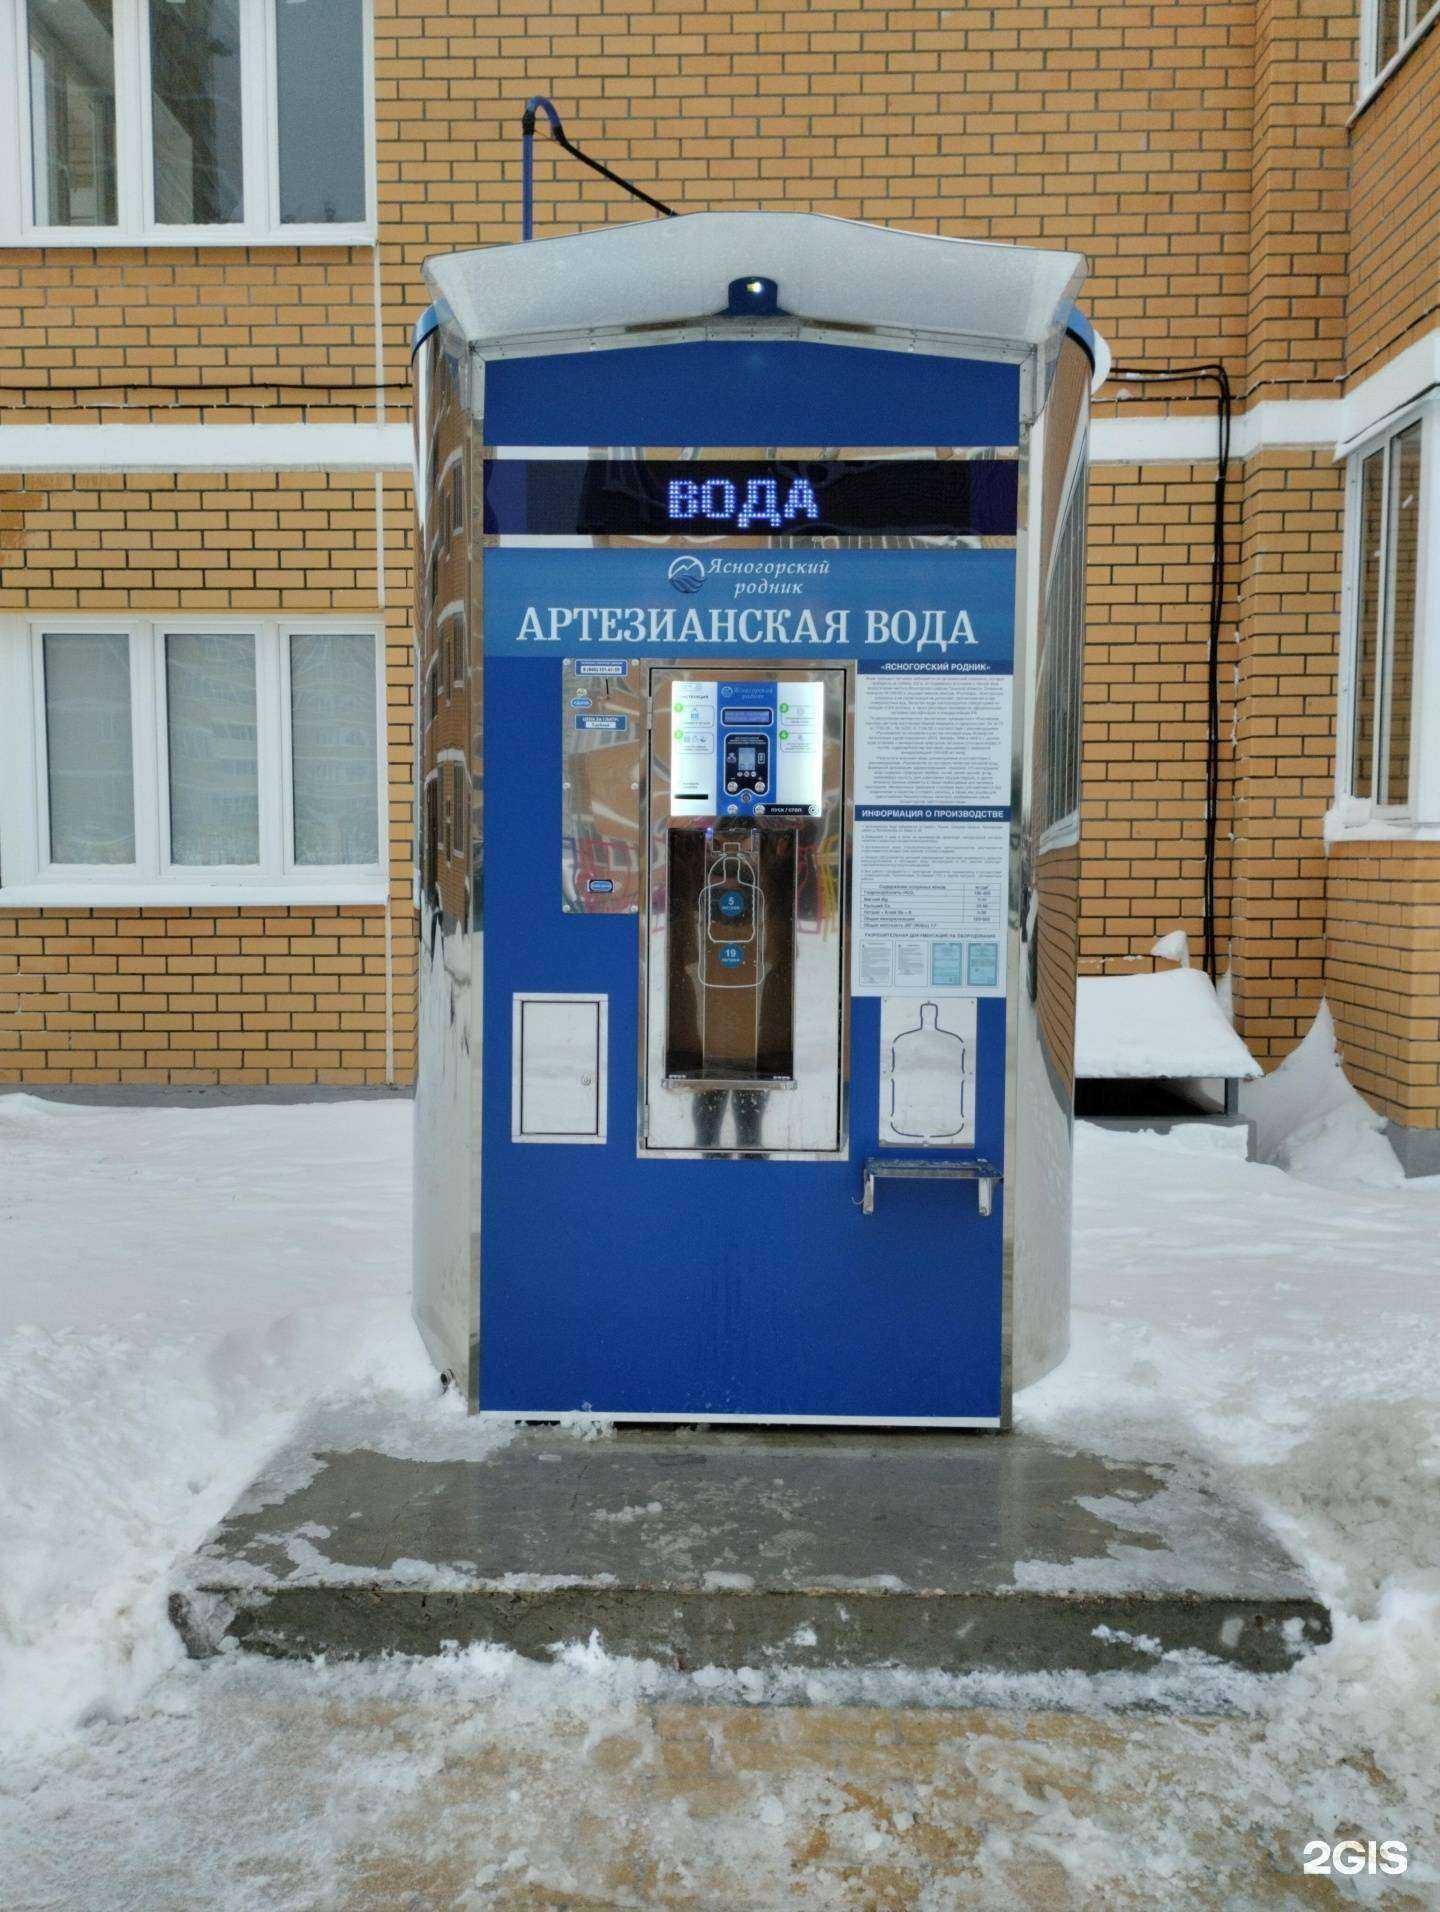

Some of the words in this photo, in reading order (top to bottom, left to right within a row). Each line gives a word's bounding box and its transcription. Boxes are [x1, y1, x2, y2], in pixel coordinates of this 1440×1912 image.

[669, 480, 818, 528] ВОДА
[708, 558, 830, 578] Ясногорский
[734, 578, 804, 598] родник
[516, 607, 850, 645] АРТЕЗИАНСКАЯ
[864, 609, 979, 653] ВОДА
[862, 809, 923, 819] ИНФОРМАЦИЯ
[925, 809, 932, 818] О
[934, 810, 1004, 819] ПРОИЗВОДСТВЕ
[728, 896, 735, 906] 5
[725, 949, 737, 958] 19
